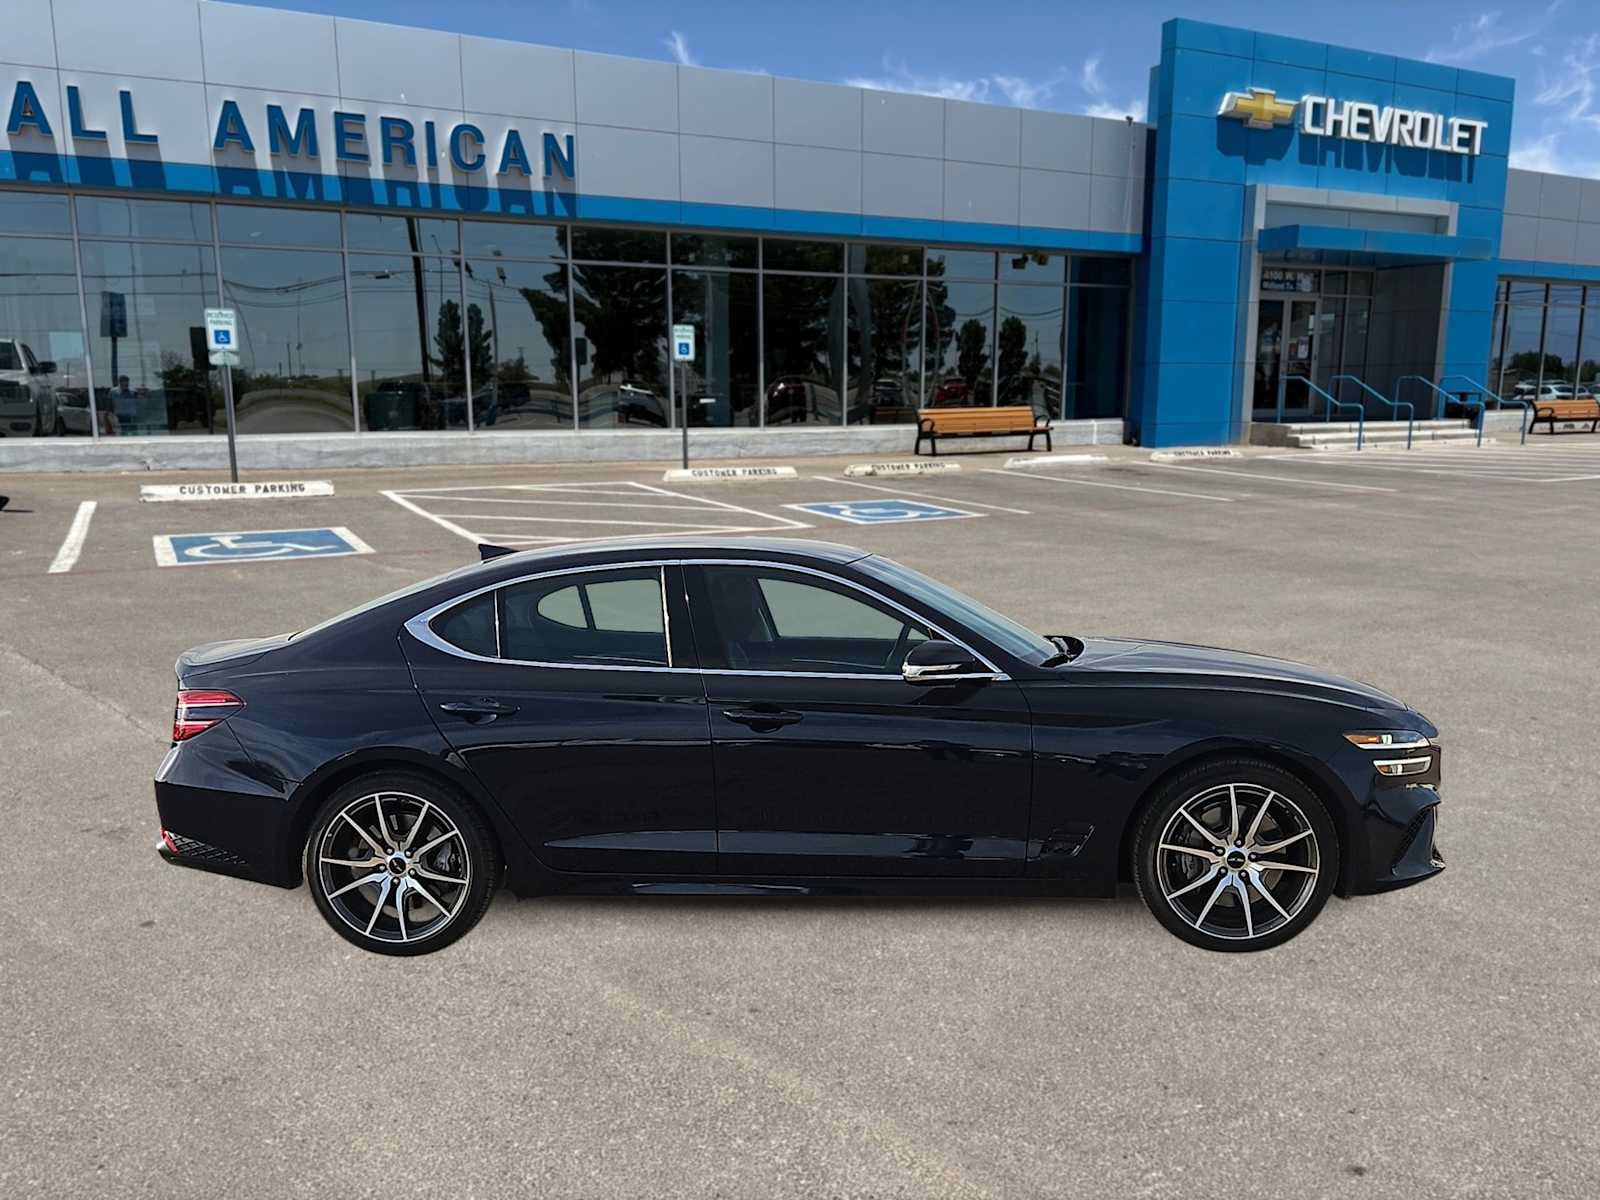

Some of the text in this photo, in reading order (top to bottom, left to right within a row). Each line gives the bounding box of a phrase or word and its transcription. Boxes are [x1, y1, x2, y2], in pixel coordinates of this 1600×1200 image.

[6, 80, 576, 181] ALL AMERICAN
[1301, 94, 1488, 156] CHEVROLET
[179, 483, 306, 496] CUSTOMER PARKING
[691, 469, 737, 477] CUSTOMER
